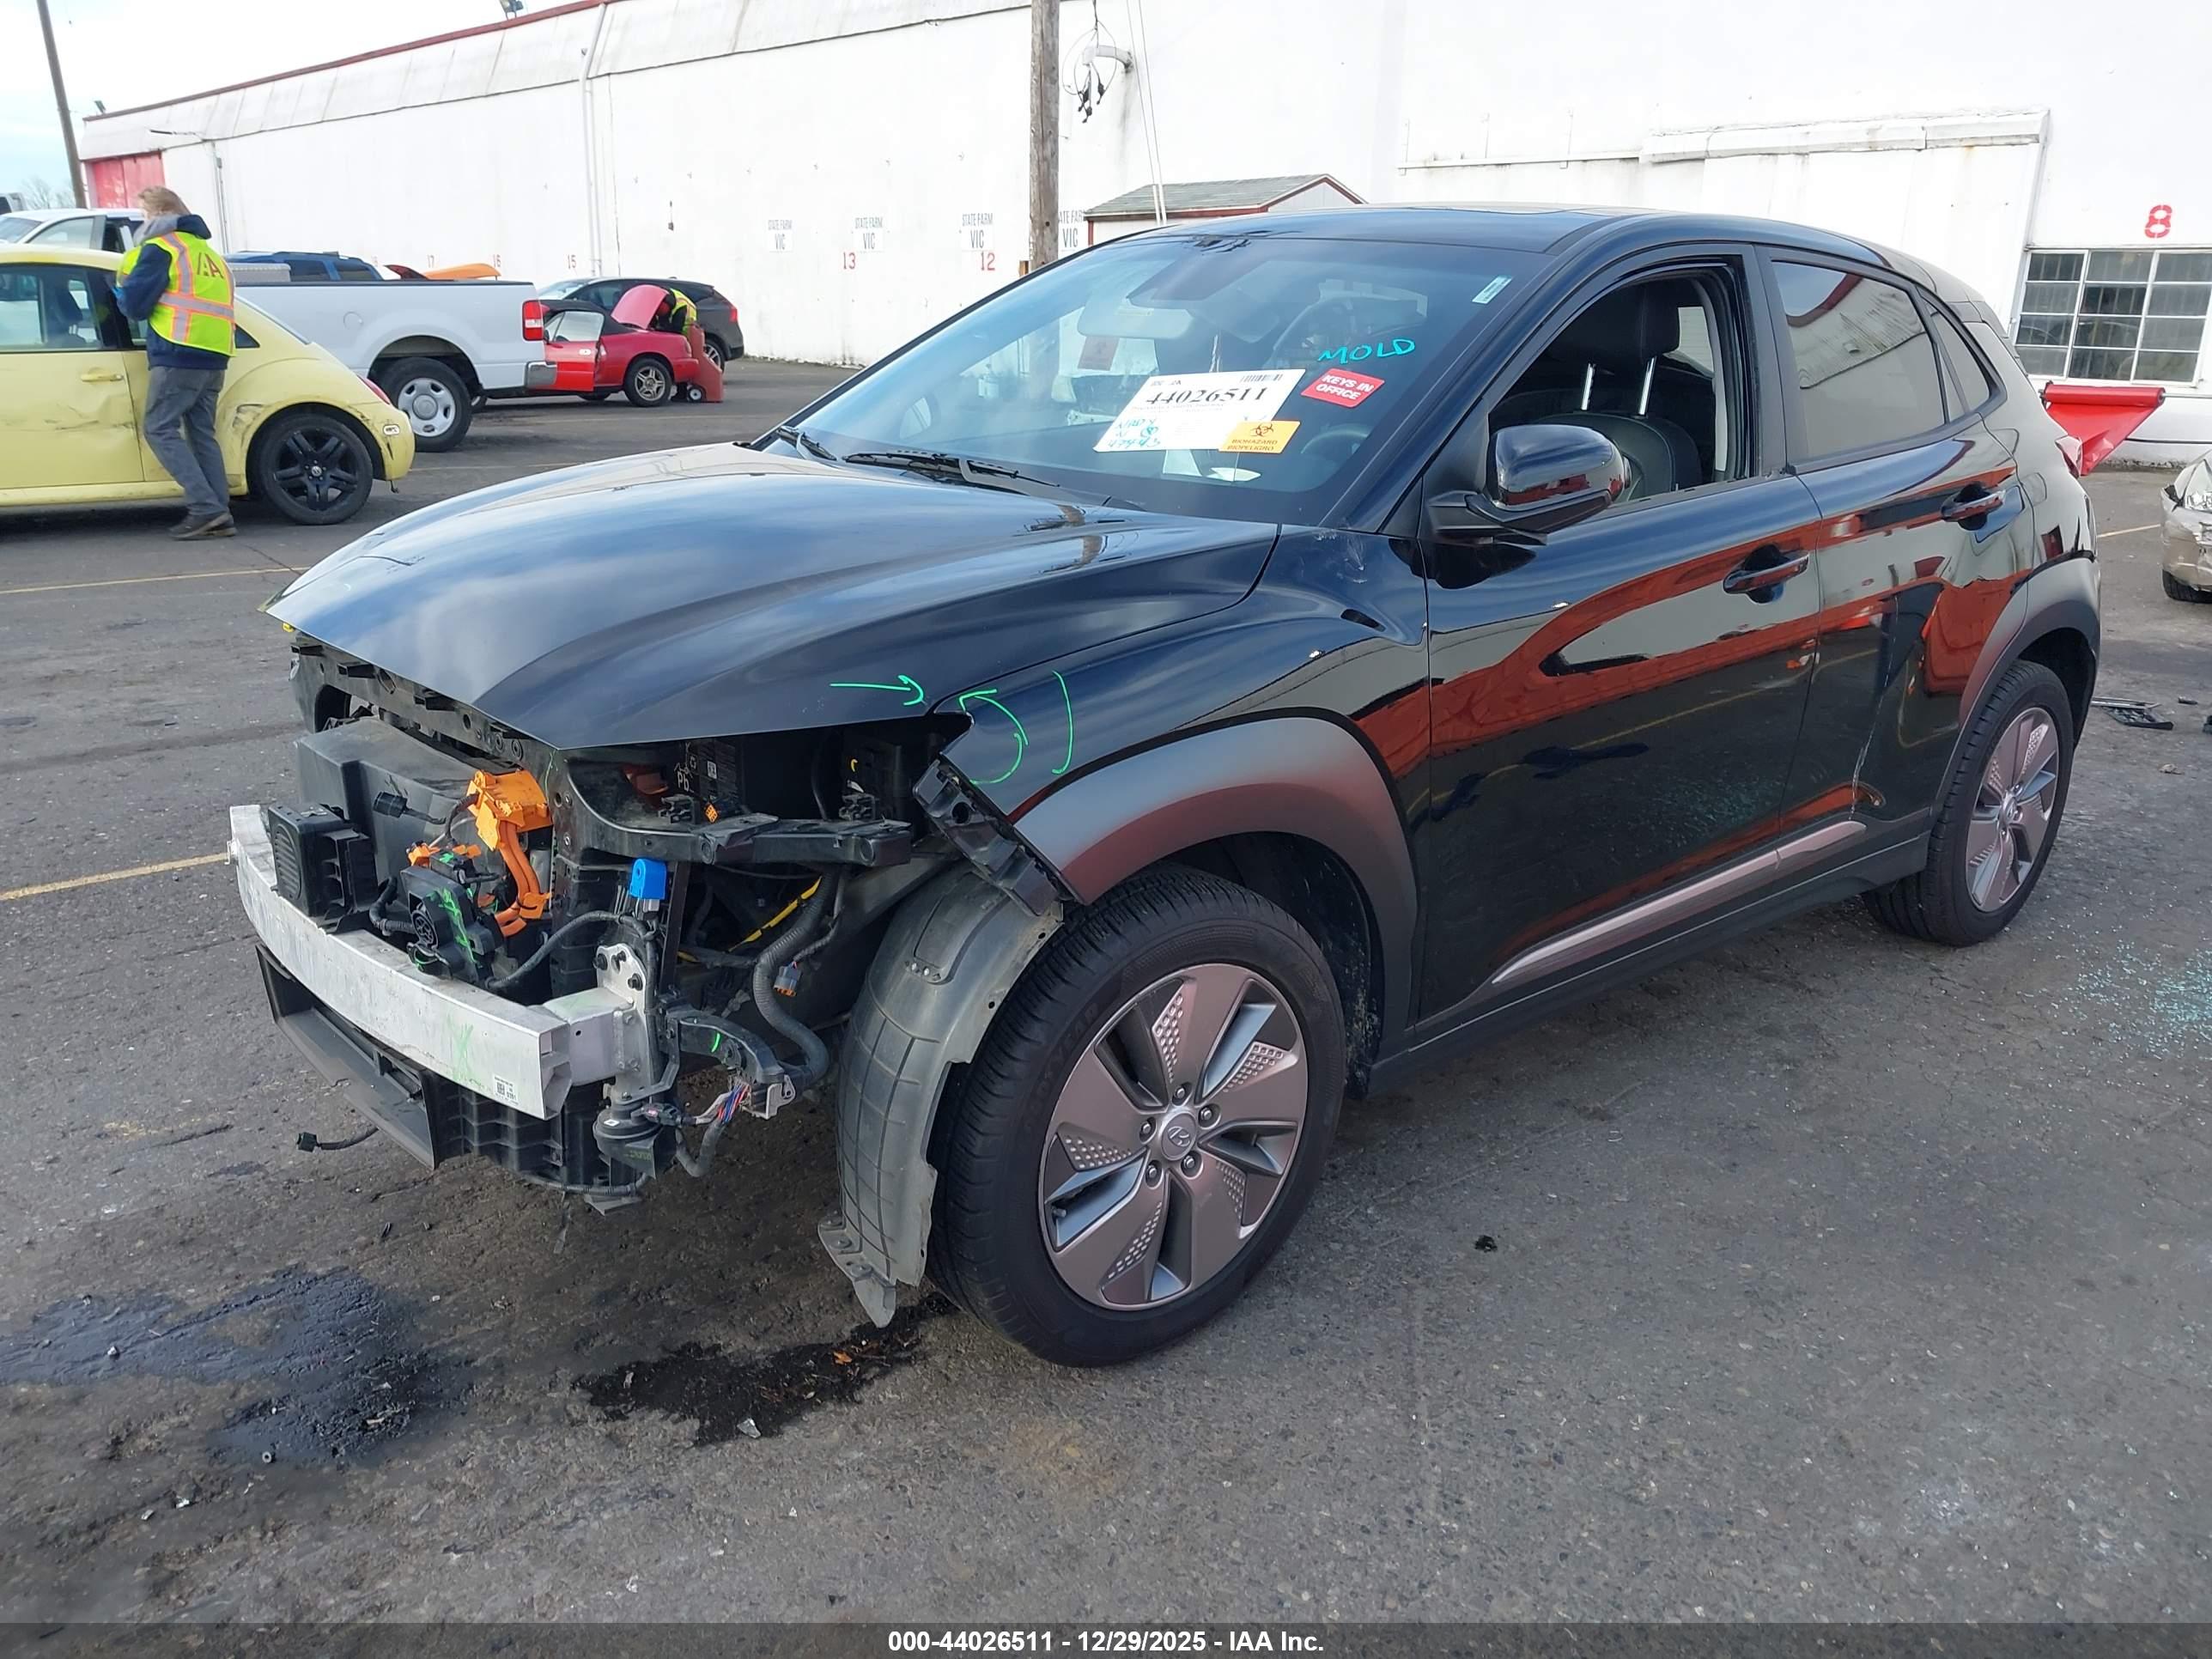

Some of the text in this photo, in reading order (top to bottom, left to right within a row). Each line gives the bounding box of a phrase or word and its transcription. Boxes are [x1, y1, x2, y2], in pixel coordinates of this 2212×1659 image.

[855, 216, 883, 228] STATE FARM
[962, 213, 994, 226] STATE FARM
[1059, 210, 1085, 224] ATE FAR
[2145, 204, 2172, 239] 8
[775, 234, 786, 250] VIC
[863, 233, 876, 249] VIC
[970, 229, 984, 248] VIC
[1063, 228, 1079, 247] VIC
[568, 254, 576, 269] 15
[842, 252, 856, 270] 13
[981, 252, 996, 270] 12
[1318, 338, 1415, 364] MOLD
[1316, 383, 1362, 400] OFFICE
[1322, 374, 1375, 392] KEYS IN
[1146, 386, 1268, 404] 44026511
